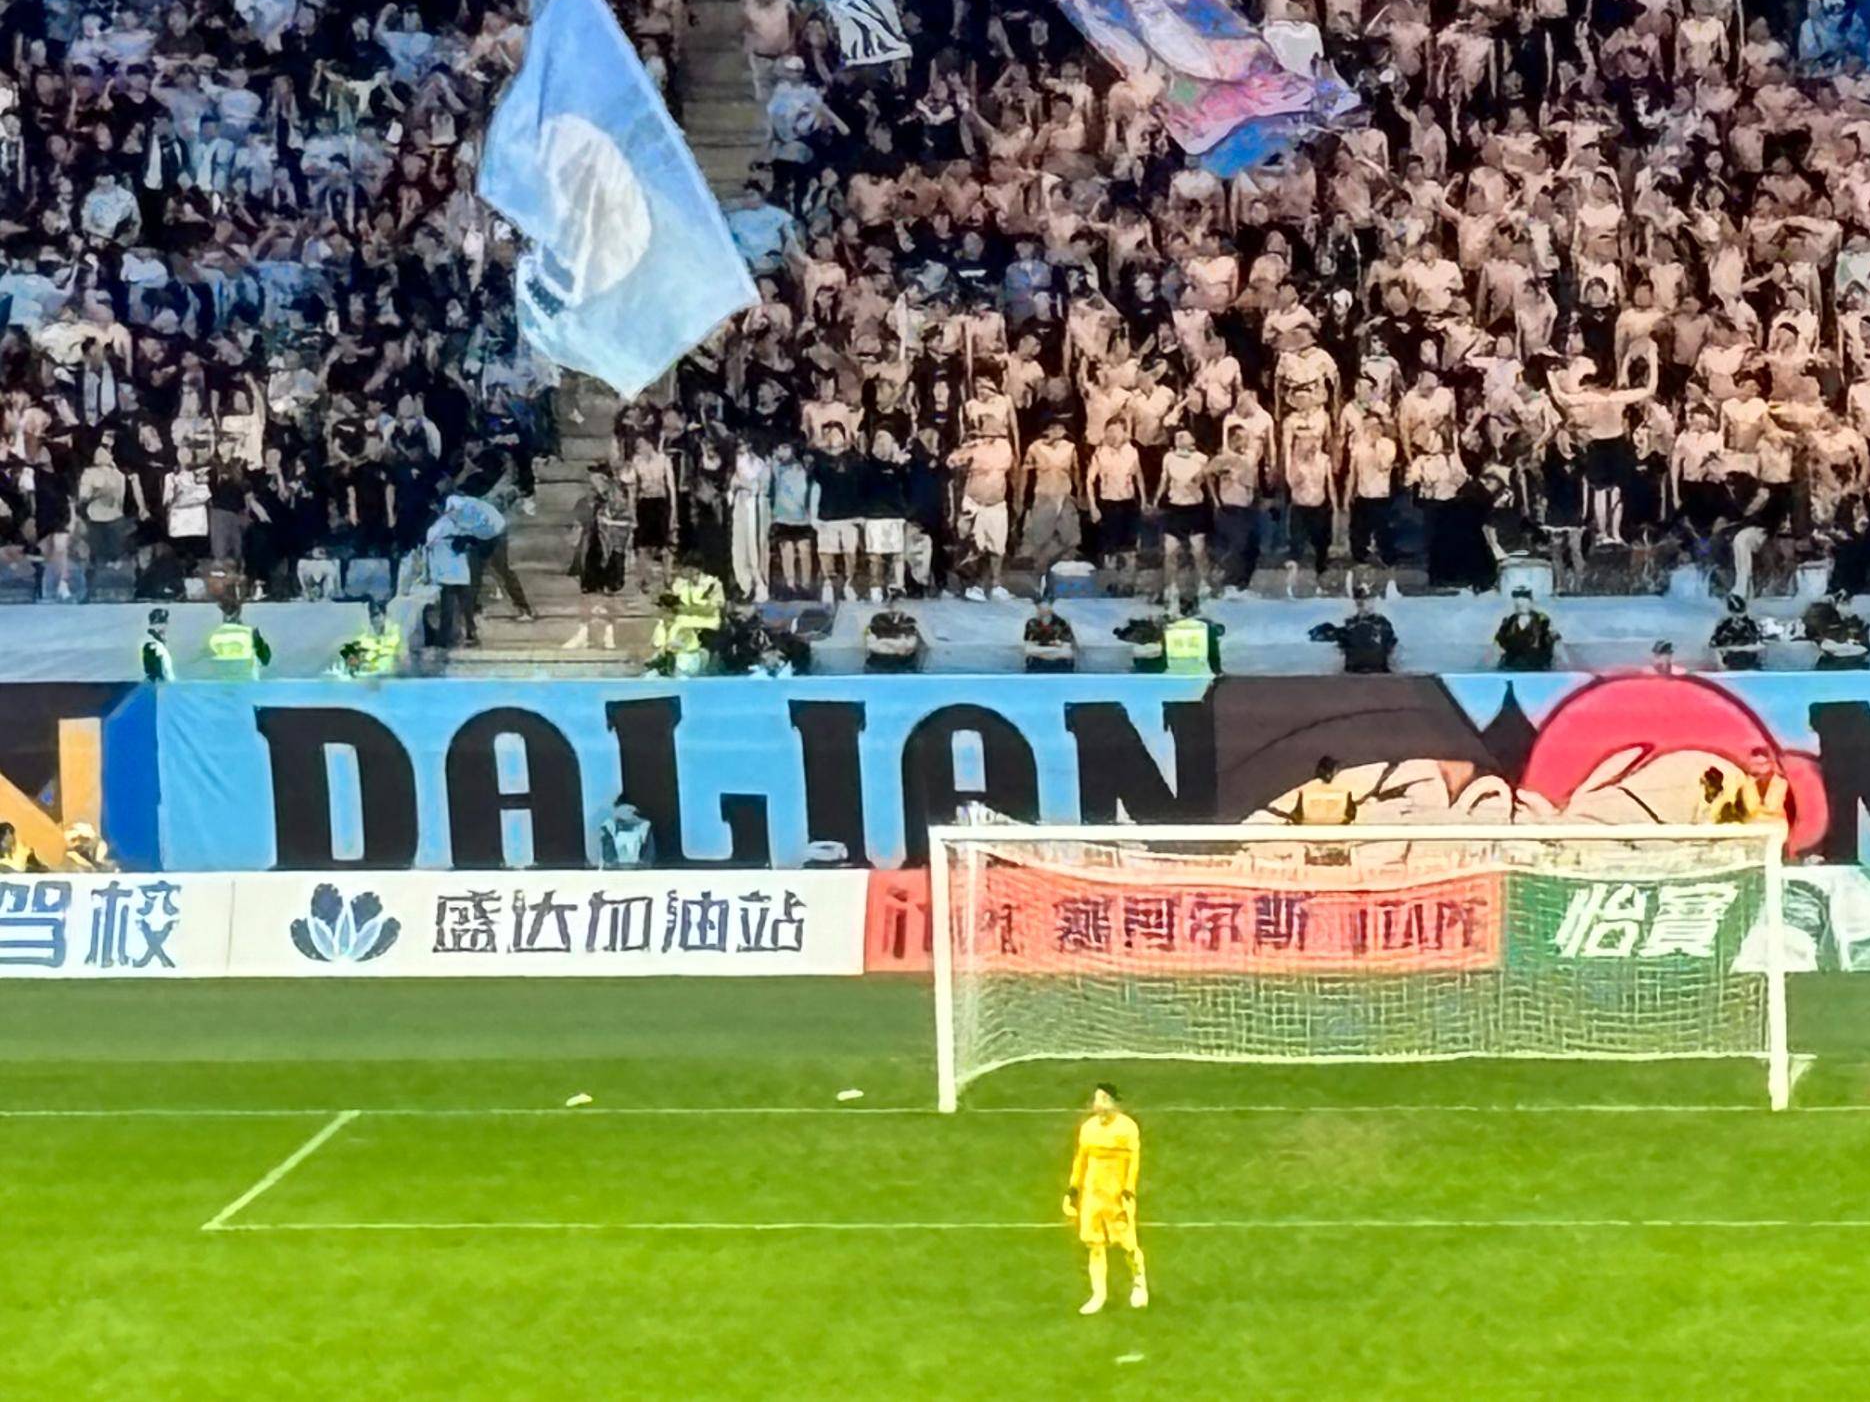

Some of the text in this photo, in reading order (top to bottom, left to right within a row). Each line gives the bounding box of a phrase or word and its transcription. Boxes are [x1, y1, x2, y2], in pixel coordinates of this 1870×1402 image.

[254, 696, 1216, 870] DALIAN
[0, 879, 182, 969] 驾校
[432, 888, 806, 954] 盛达加油站
[1554, 881, 1740, 959] 怡寶
